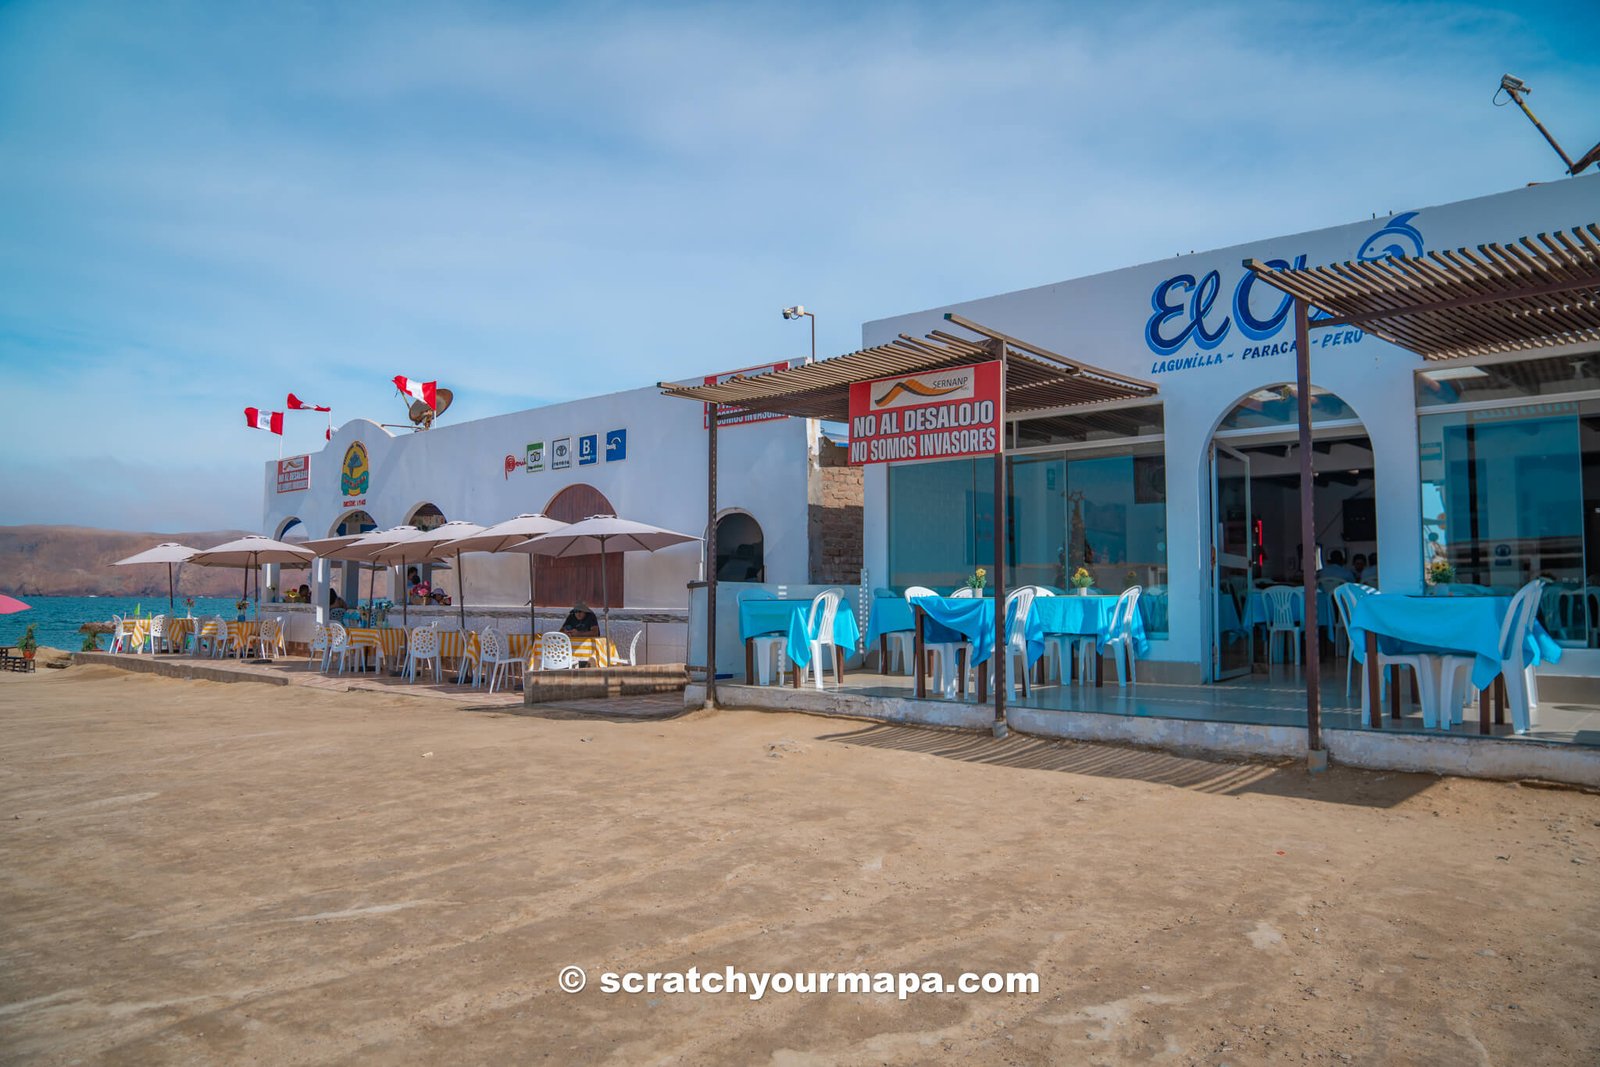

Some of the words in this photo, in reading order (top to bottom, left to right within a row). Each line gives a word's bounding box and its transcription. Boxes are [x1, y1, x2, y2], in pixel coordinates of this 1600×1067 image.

[1145, 269, 1231, 356] El
[1242, 341, 1297, 360] PARACA
[932, 376, 968, 389] SERNANP
[853, 415, 876, 438] NO
[880, 412, 899, 435] AL
[904, 400, 994, 432] DESALOJO
[851, 441, 867, 463] NO
[870, 435, 916, 461] SOMOS
[920, 427, 996, 456] INVASORES
